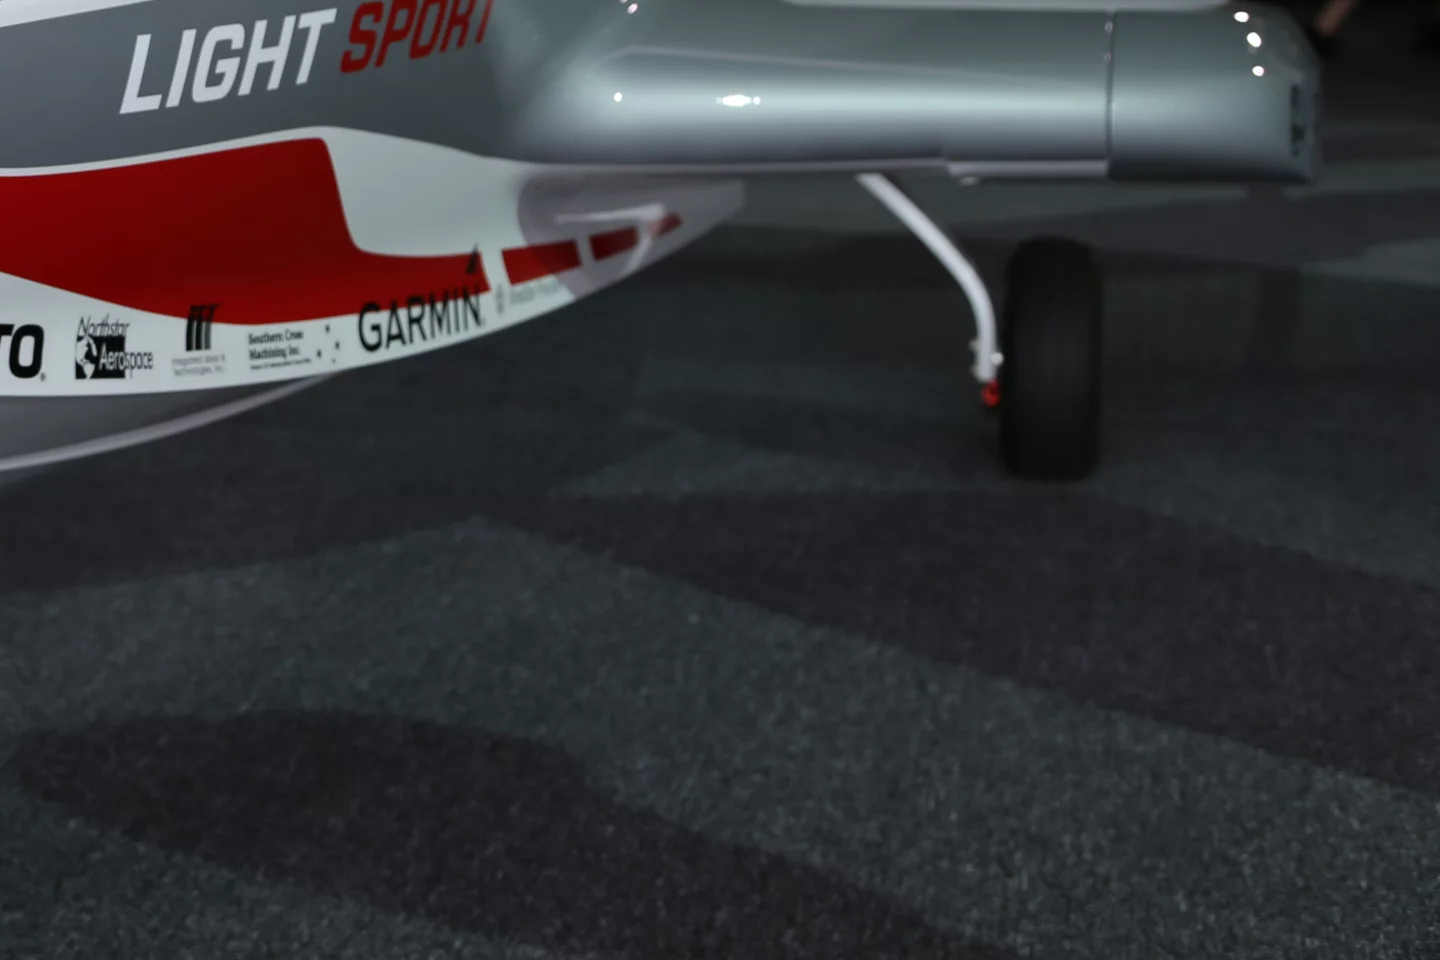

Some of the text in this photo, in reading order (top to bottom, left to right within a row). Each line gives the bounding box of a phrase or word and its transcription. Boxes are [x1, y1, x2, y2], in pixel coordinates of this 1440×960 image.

[119, 8, 337, 115] LIGHT
[76, 314, 130, 337] Northstar
[357, 284, 482, 353] GARMIN
[98, 342, 154, 378] Aerospace
